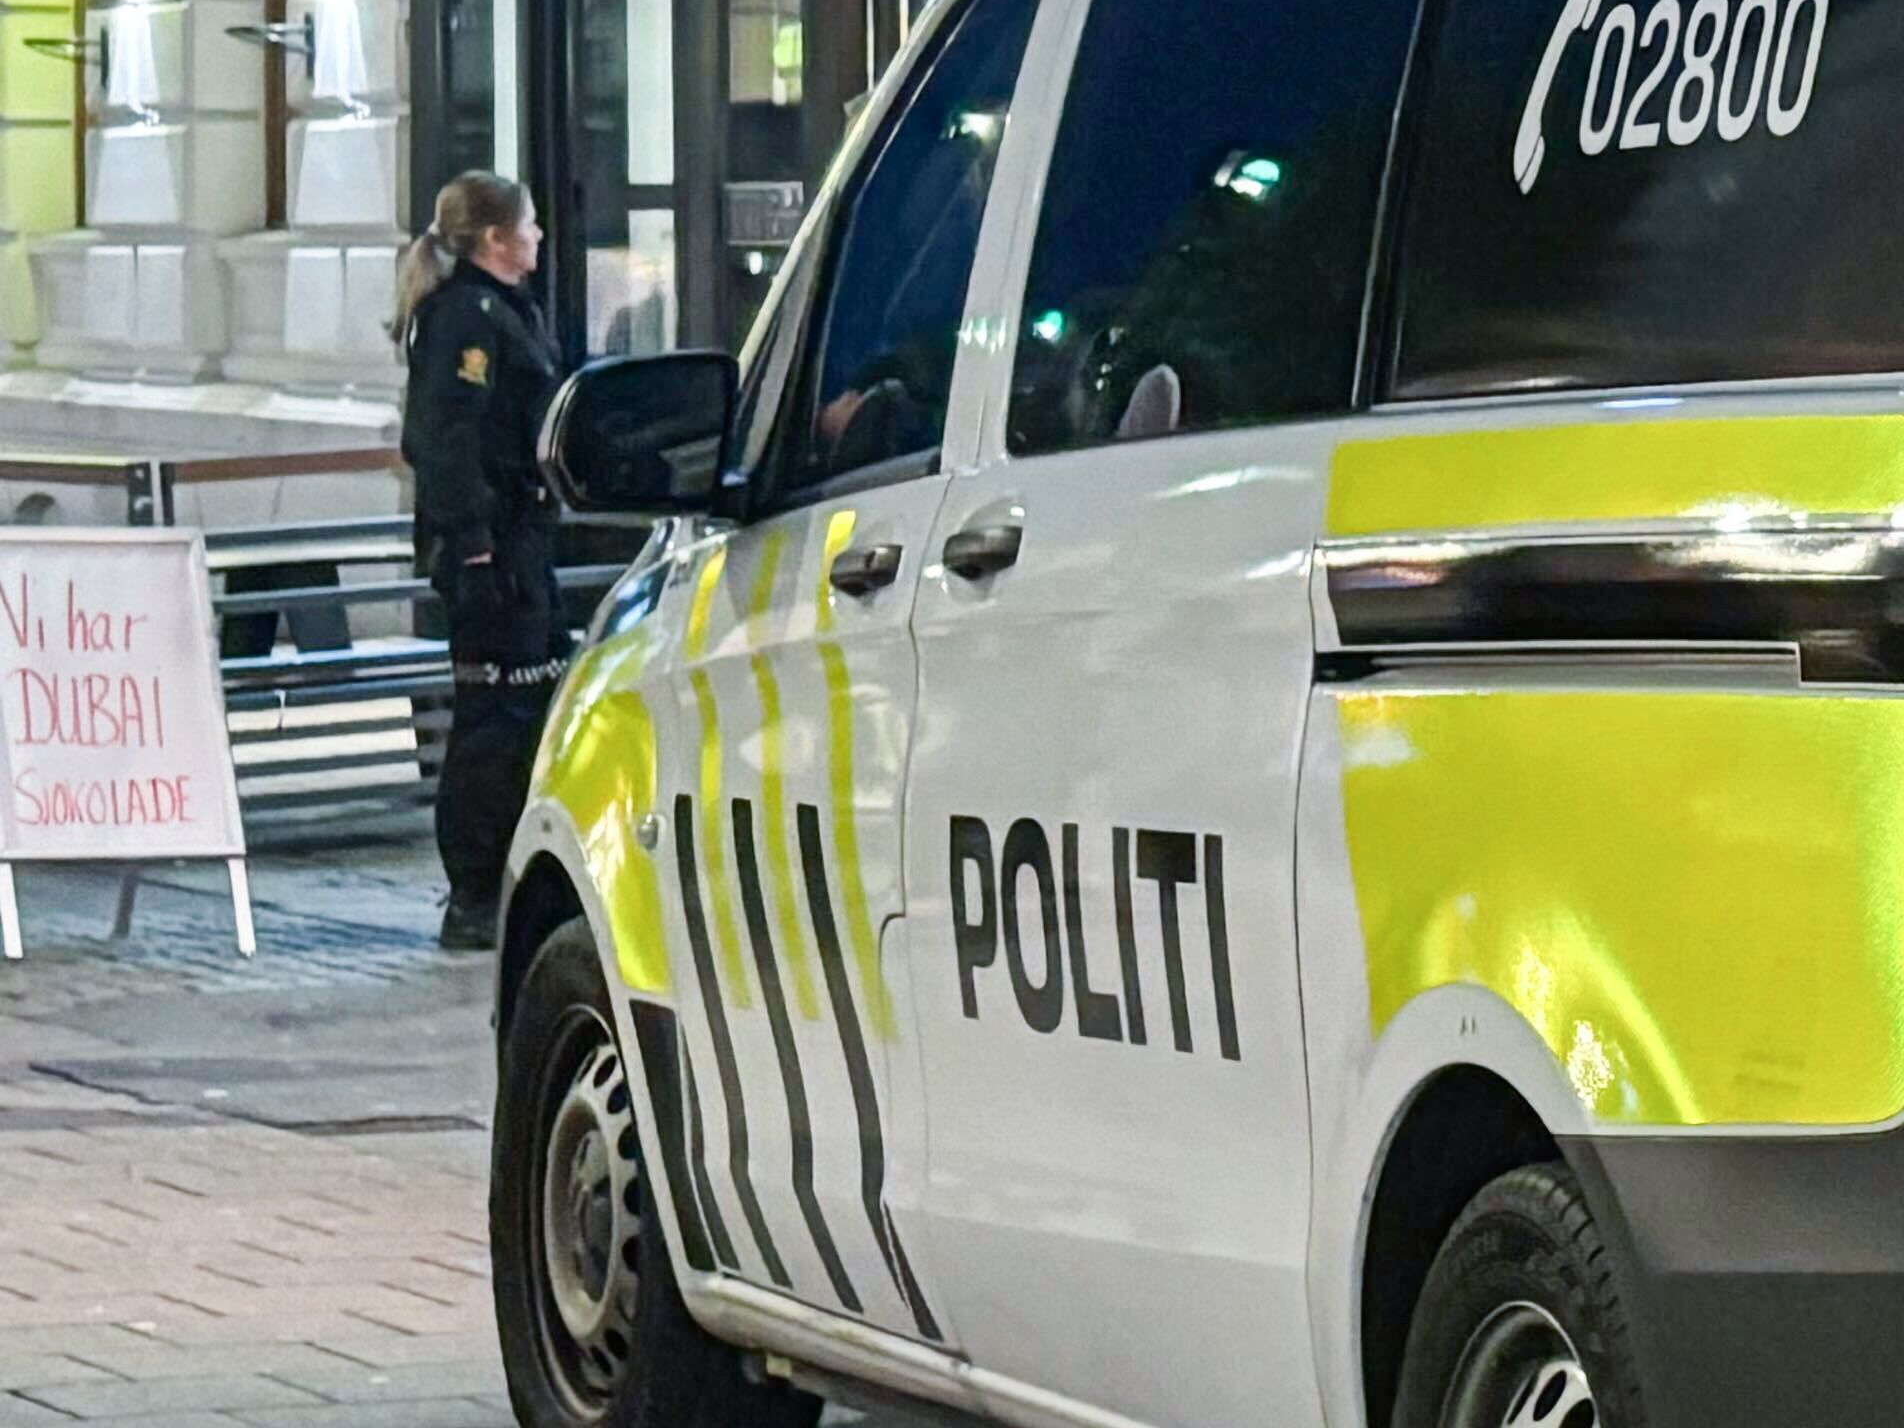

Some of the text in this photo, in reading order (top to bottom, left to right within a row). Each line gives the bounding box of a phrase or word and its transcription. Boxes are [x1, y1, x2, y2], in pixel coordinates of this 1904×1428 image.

[67, 579, 147, 652] har
[14, 668, 164, 748] DUBAI
[949, 813, 1242, 1062] POLITI
